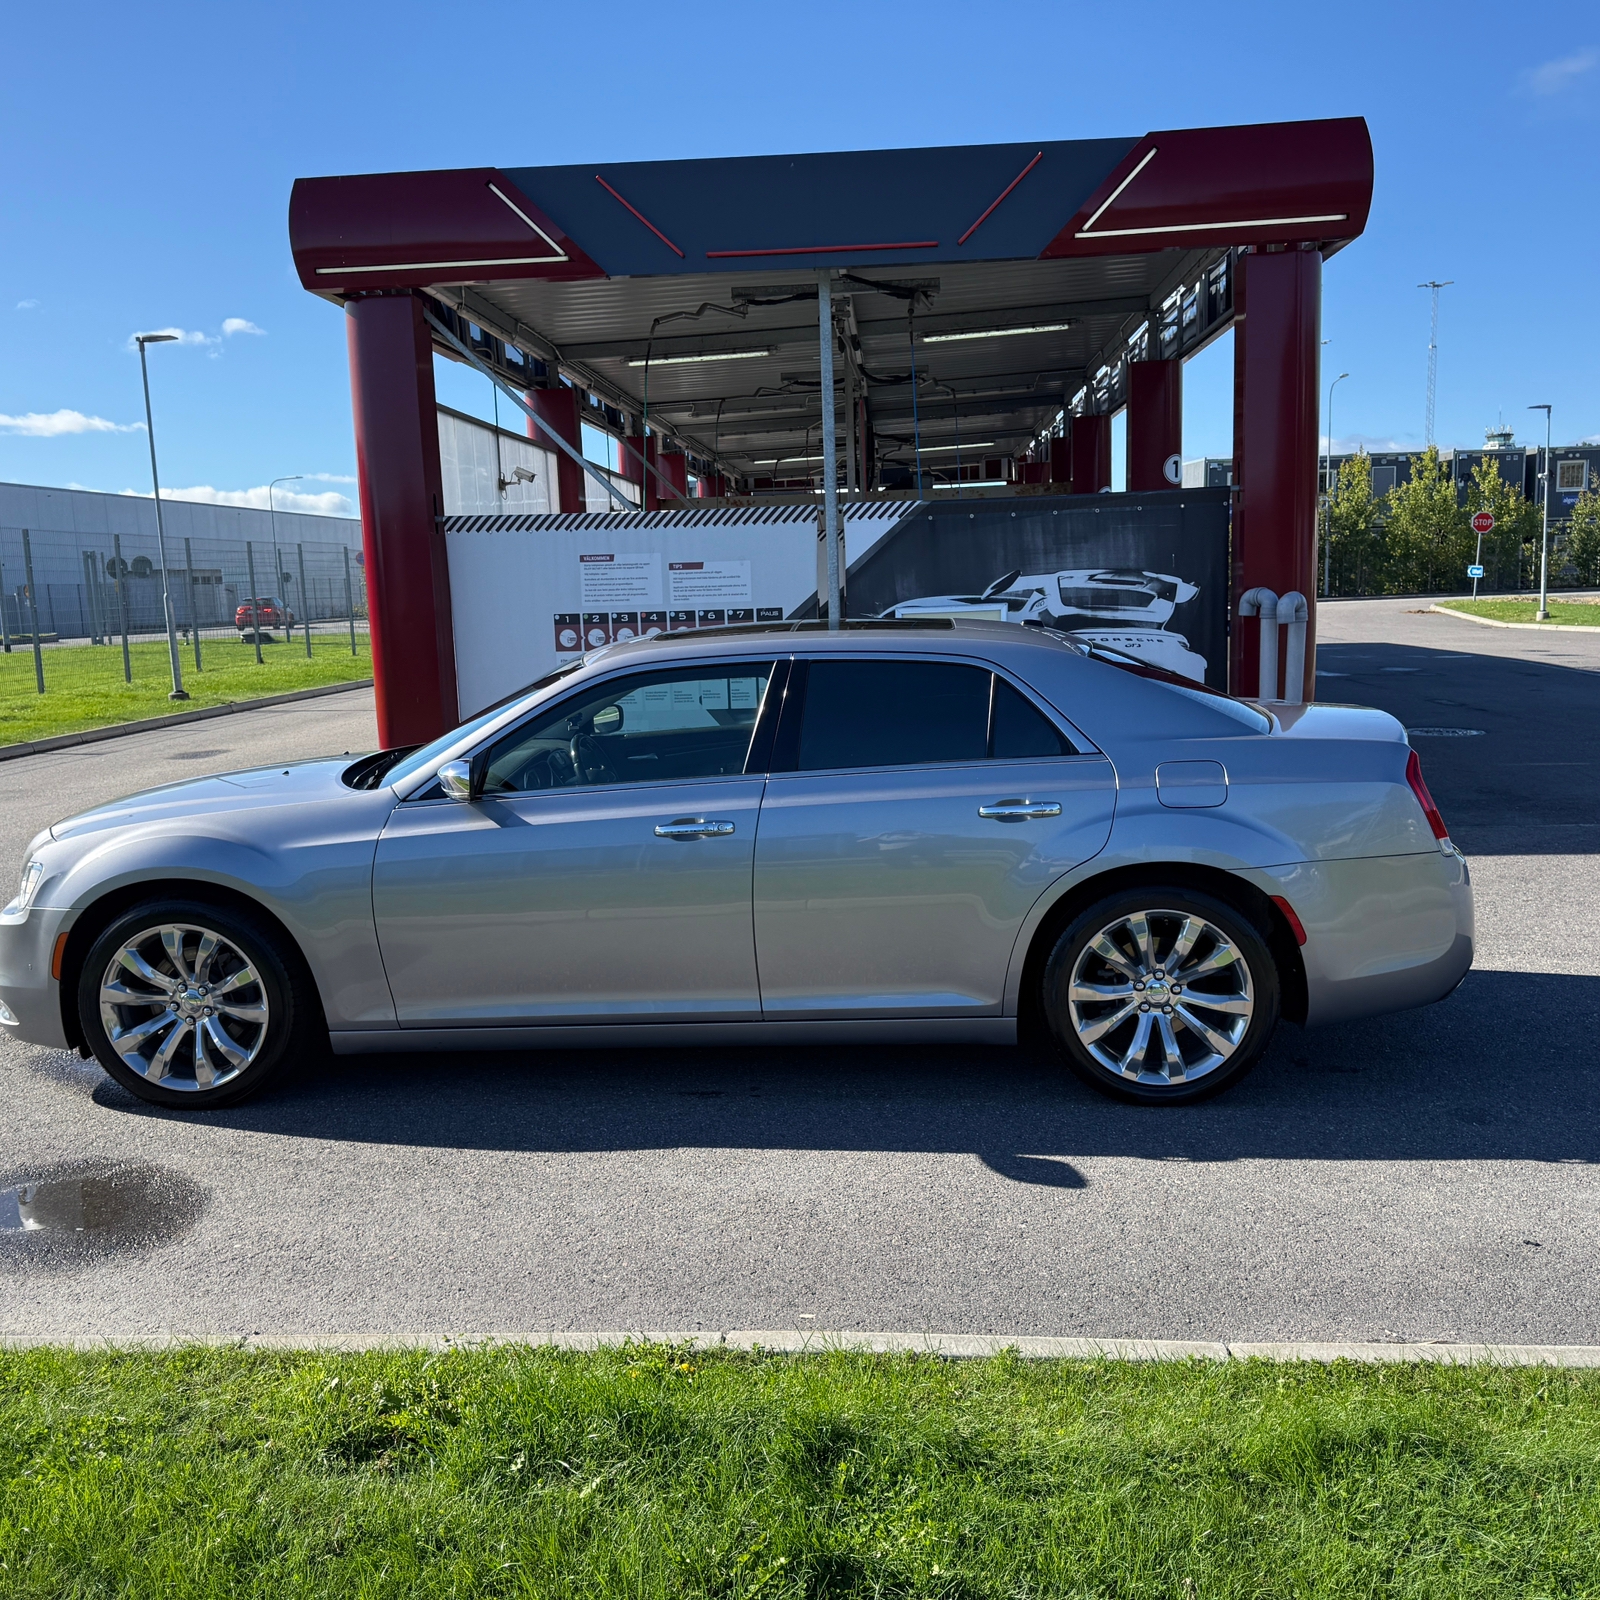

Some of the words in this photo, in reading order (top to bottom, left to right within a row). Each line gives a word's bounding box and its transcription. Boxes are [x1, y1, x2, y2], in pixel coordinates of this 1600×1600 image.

[1172, 460, 1179, 478] 1
[1474, 518, 1493, 526] STOP
[621, 614, 629, 622] 3
[649, 613, 658, 621] 4
[678, 612, 687, 620] 5
[707, 611, 716, 619] 6
[736, 610, 745, 618] 7
[565, 615, 570, 623] 1
